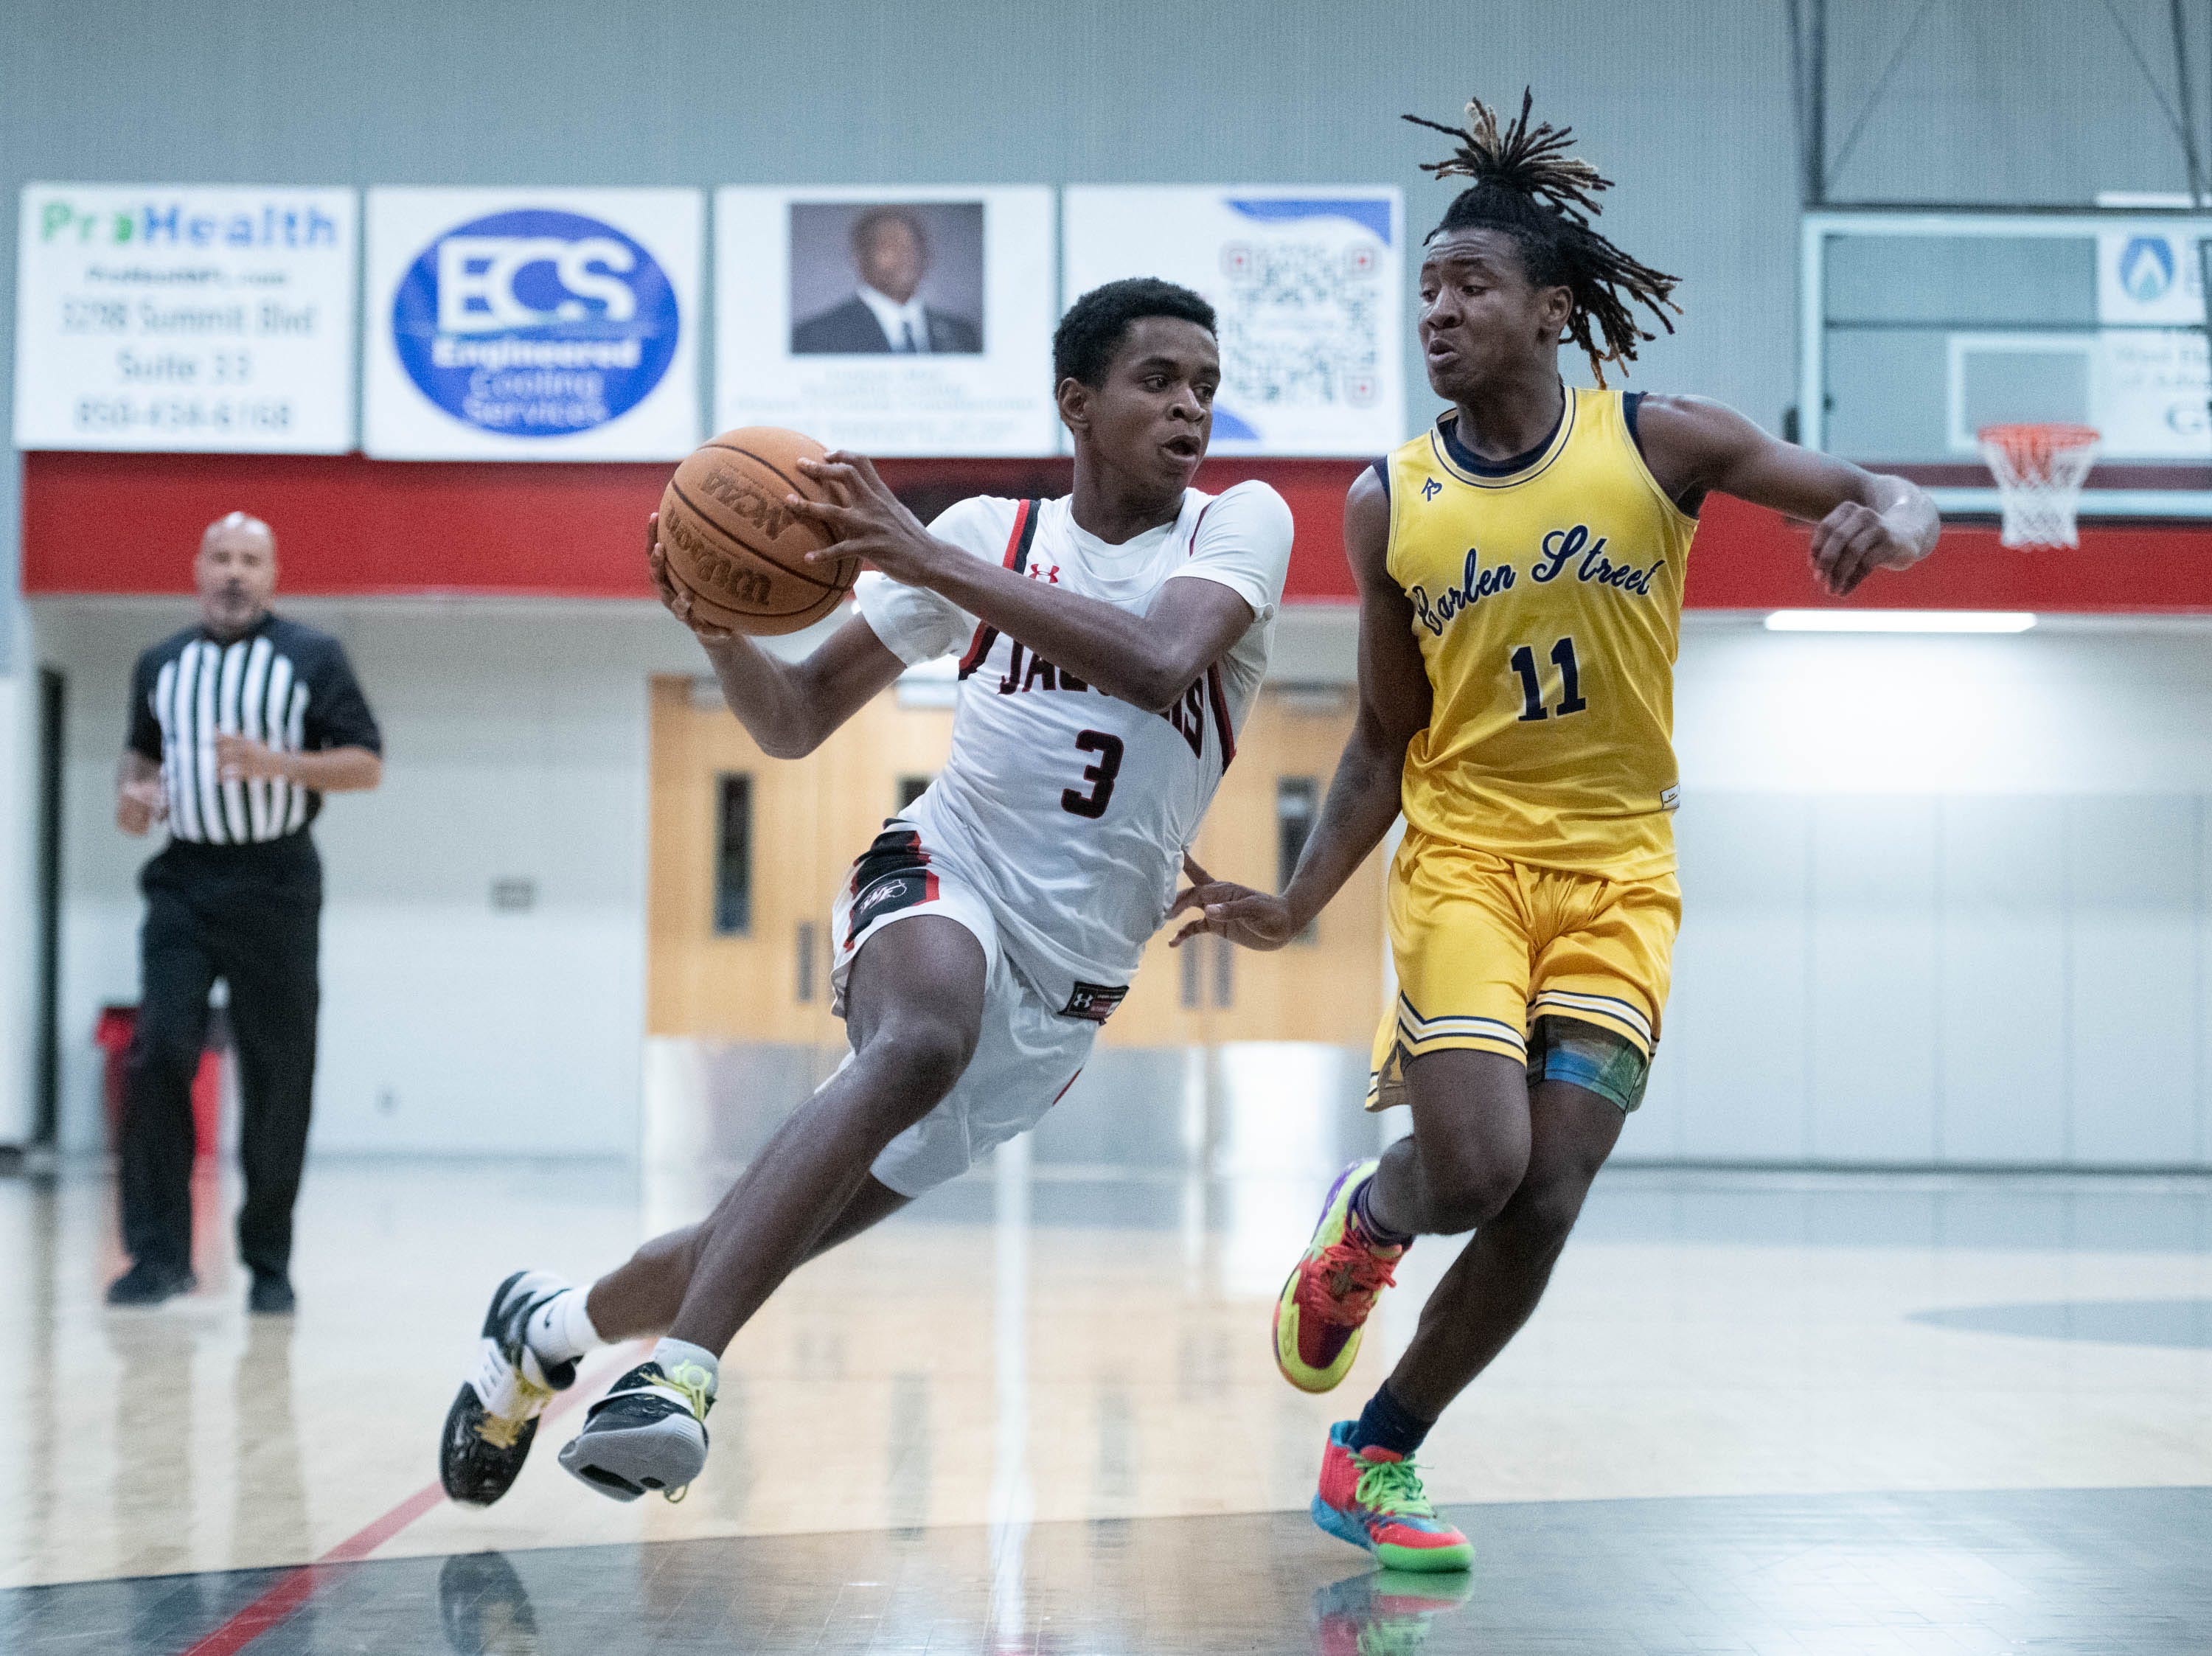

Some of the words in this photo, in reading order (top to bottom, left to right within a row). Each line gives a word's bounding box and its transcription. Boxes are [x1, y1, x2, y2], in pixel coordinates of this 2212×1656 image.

[439, 238, 636, 332] ECS
[434, 338, 640, 370] Engineered
[701, 470, 797, 541] NCAA
[665, 501, 772, 606] Wilson
[1531, 524, 1666, 596] Street
[1511, 637, 1587, 722] 11
[1060, 729, 1124, 819] 3
